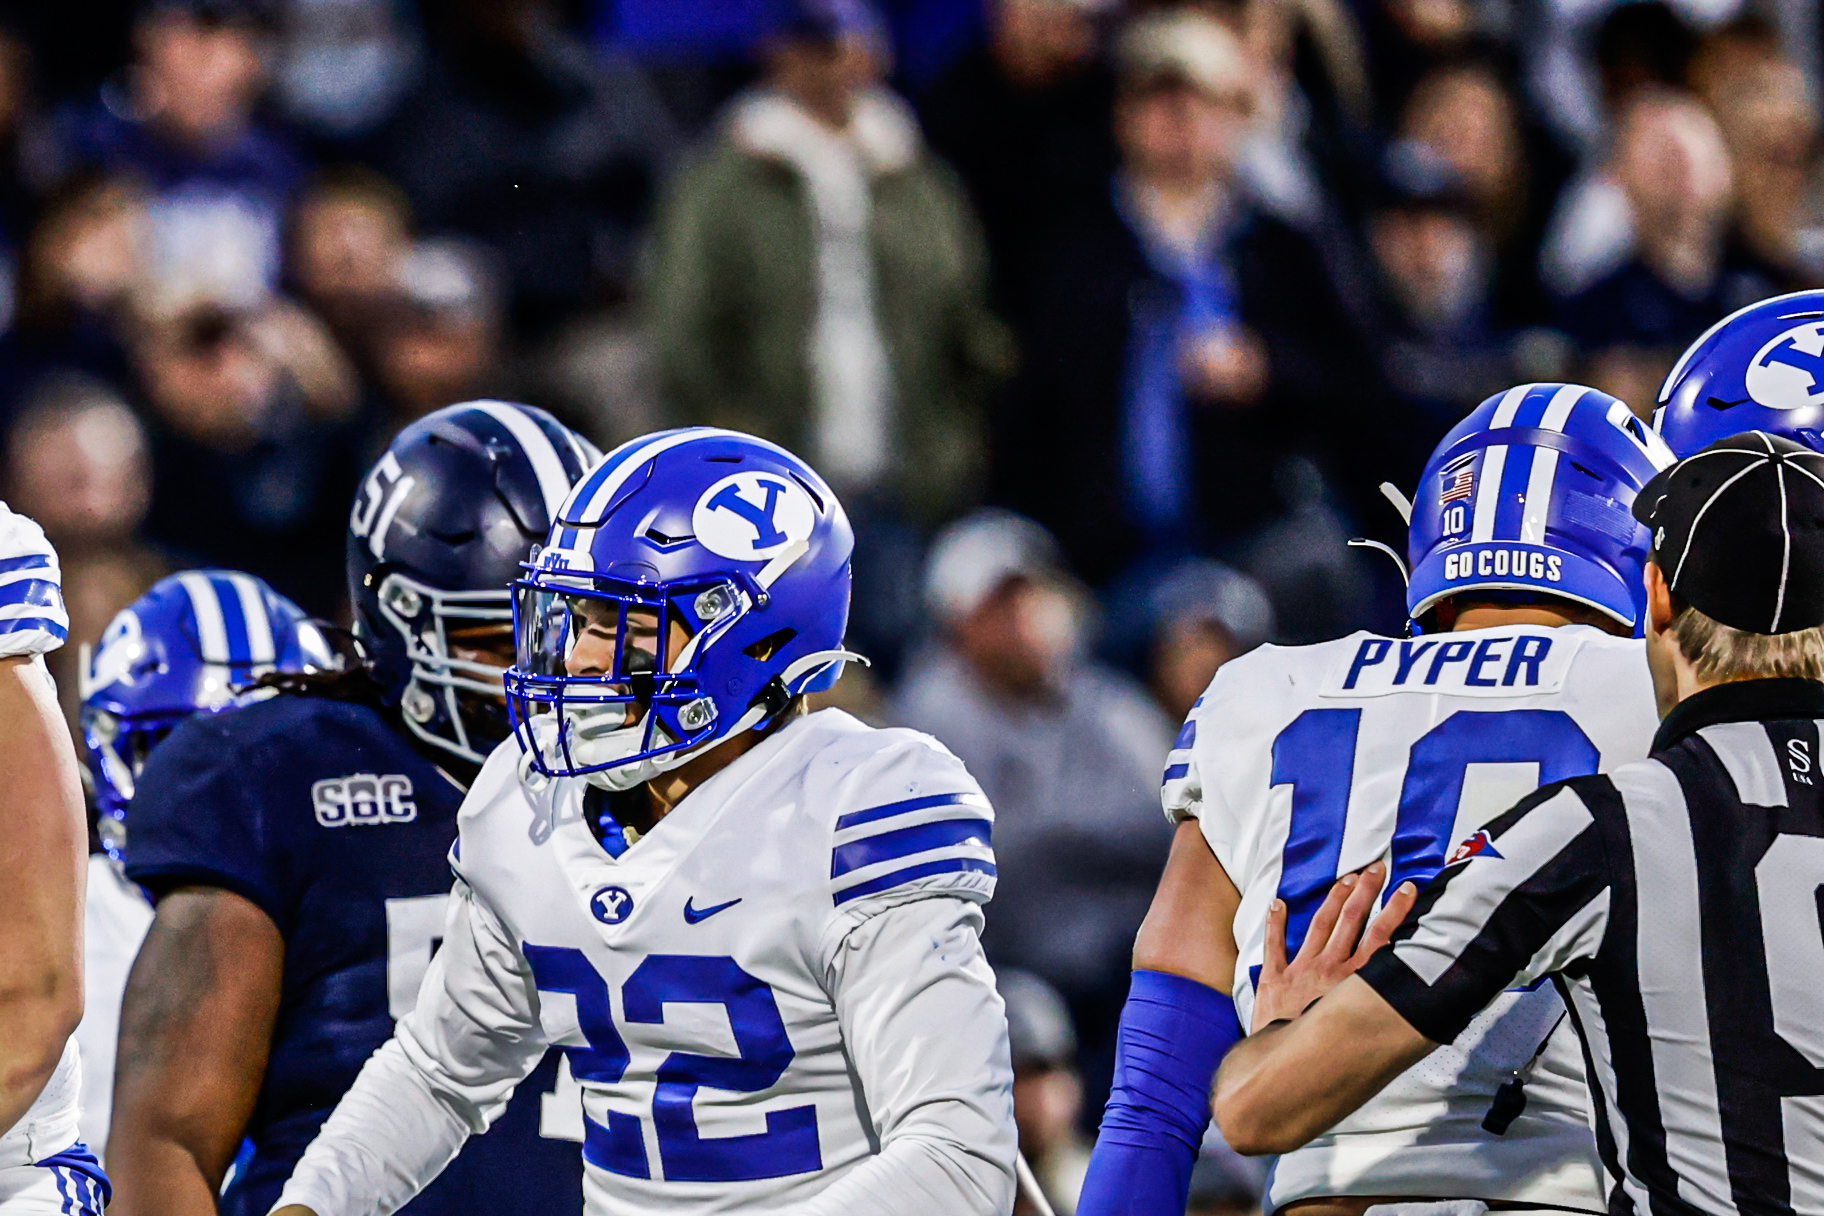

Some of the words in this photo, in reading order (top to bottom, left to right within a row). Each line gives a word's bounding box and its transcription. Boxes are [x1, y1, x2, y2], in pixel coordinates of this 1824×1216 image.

[350, 451, 416, 562] 51
[705, 479, 787, 550] Y
[1442, 506, 1465, 537] 10
[1444, 551, 1474, 581] GO
[1477, 549, 1563, 582] COUGS
[1342, 635, 1553, 689] PYPER
[311, 773, 417, 828] SBC
[522, 940, 823, 1182] 22
